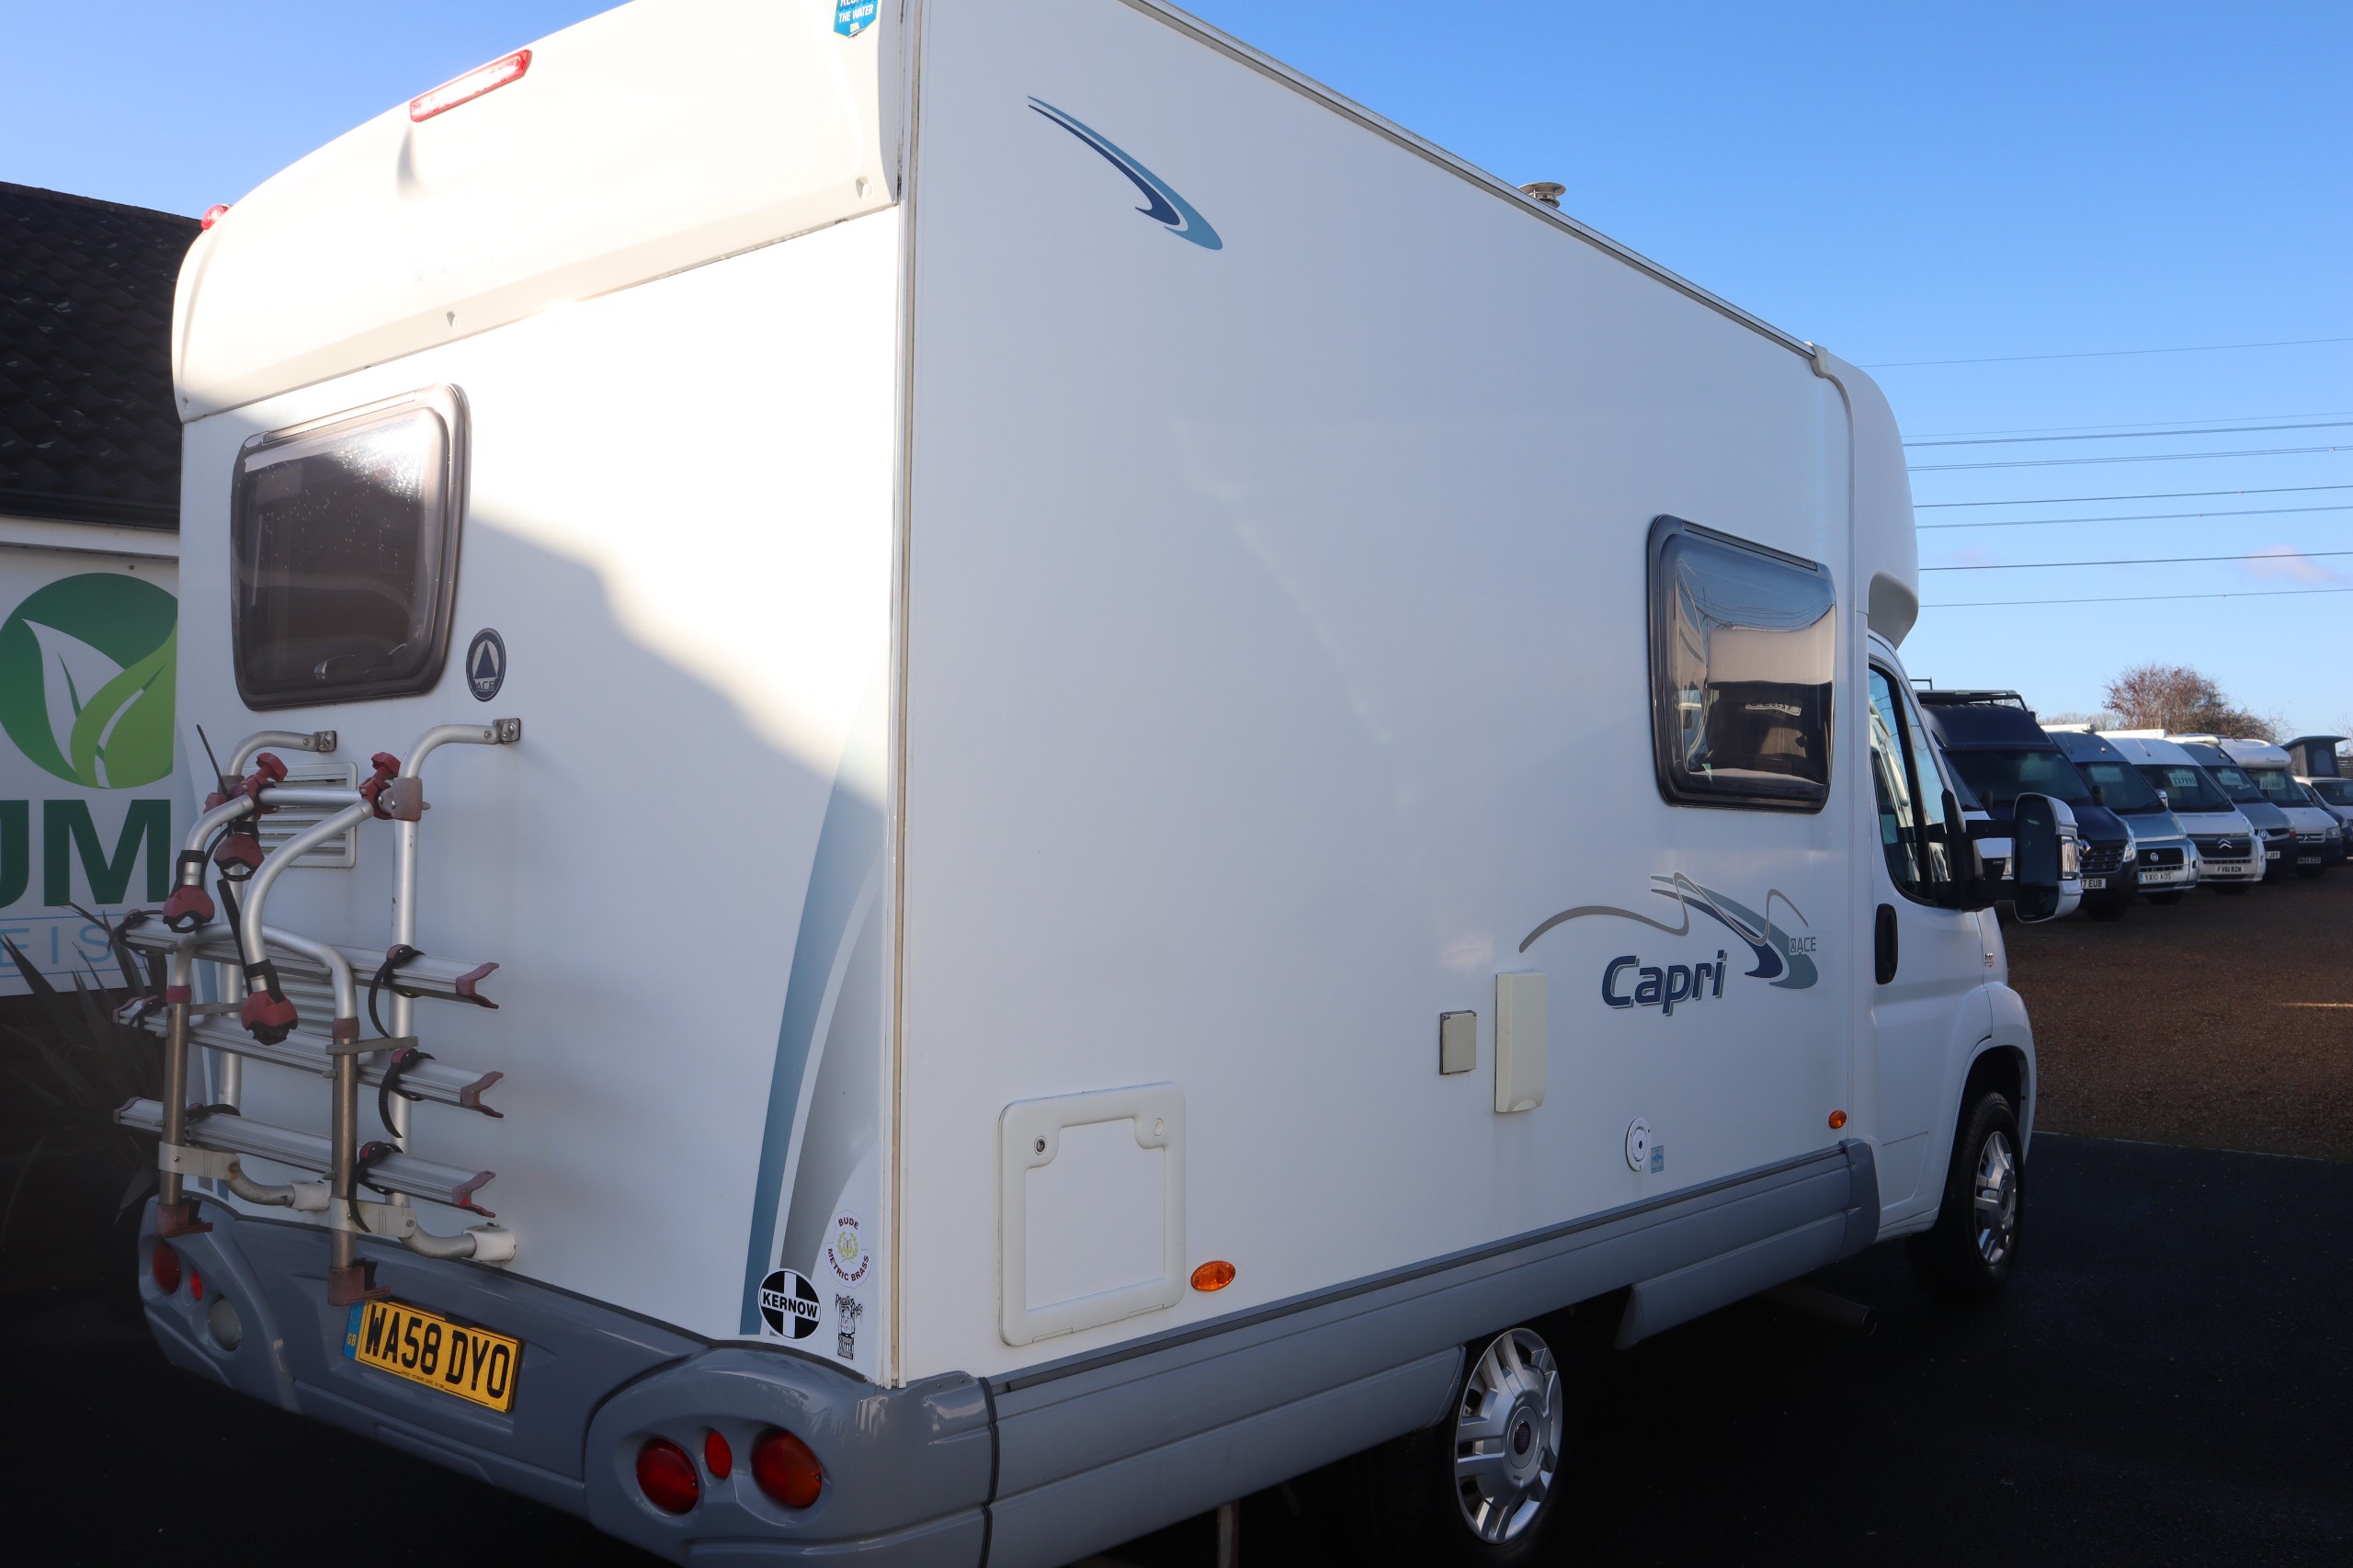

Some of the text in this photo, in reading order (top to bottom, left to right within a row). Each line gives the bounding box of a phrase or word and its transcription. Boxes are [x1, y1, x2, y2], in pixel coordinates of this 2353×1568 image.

[839, 5, 873, 23] THE WATER
[475, 680, 495, 692] ACE
[2088, 879, 2102, 887] EUB
[0, 925, 147, 967] EIS
[1601, 949, 1727, 1017] Capri
[838, 1216, 859, 1230] BUDE
[827, 1248, 870, 1281] METRIC BRASS
[762, 1290, 818, 1319] KERNOW
[347, 1334, 357, 1347] GB
[365, 1304, 510, 1399] WA58 DYO
